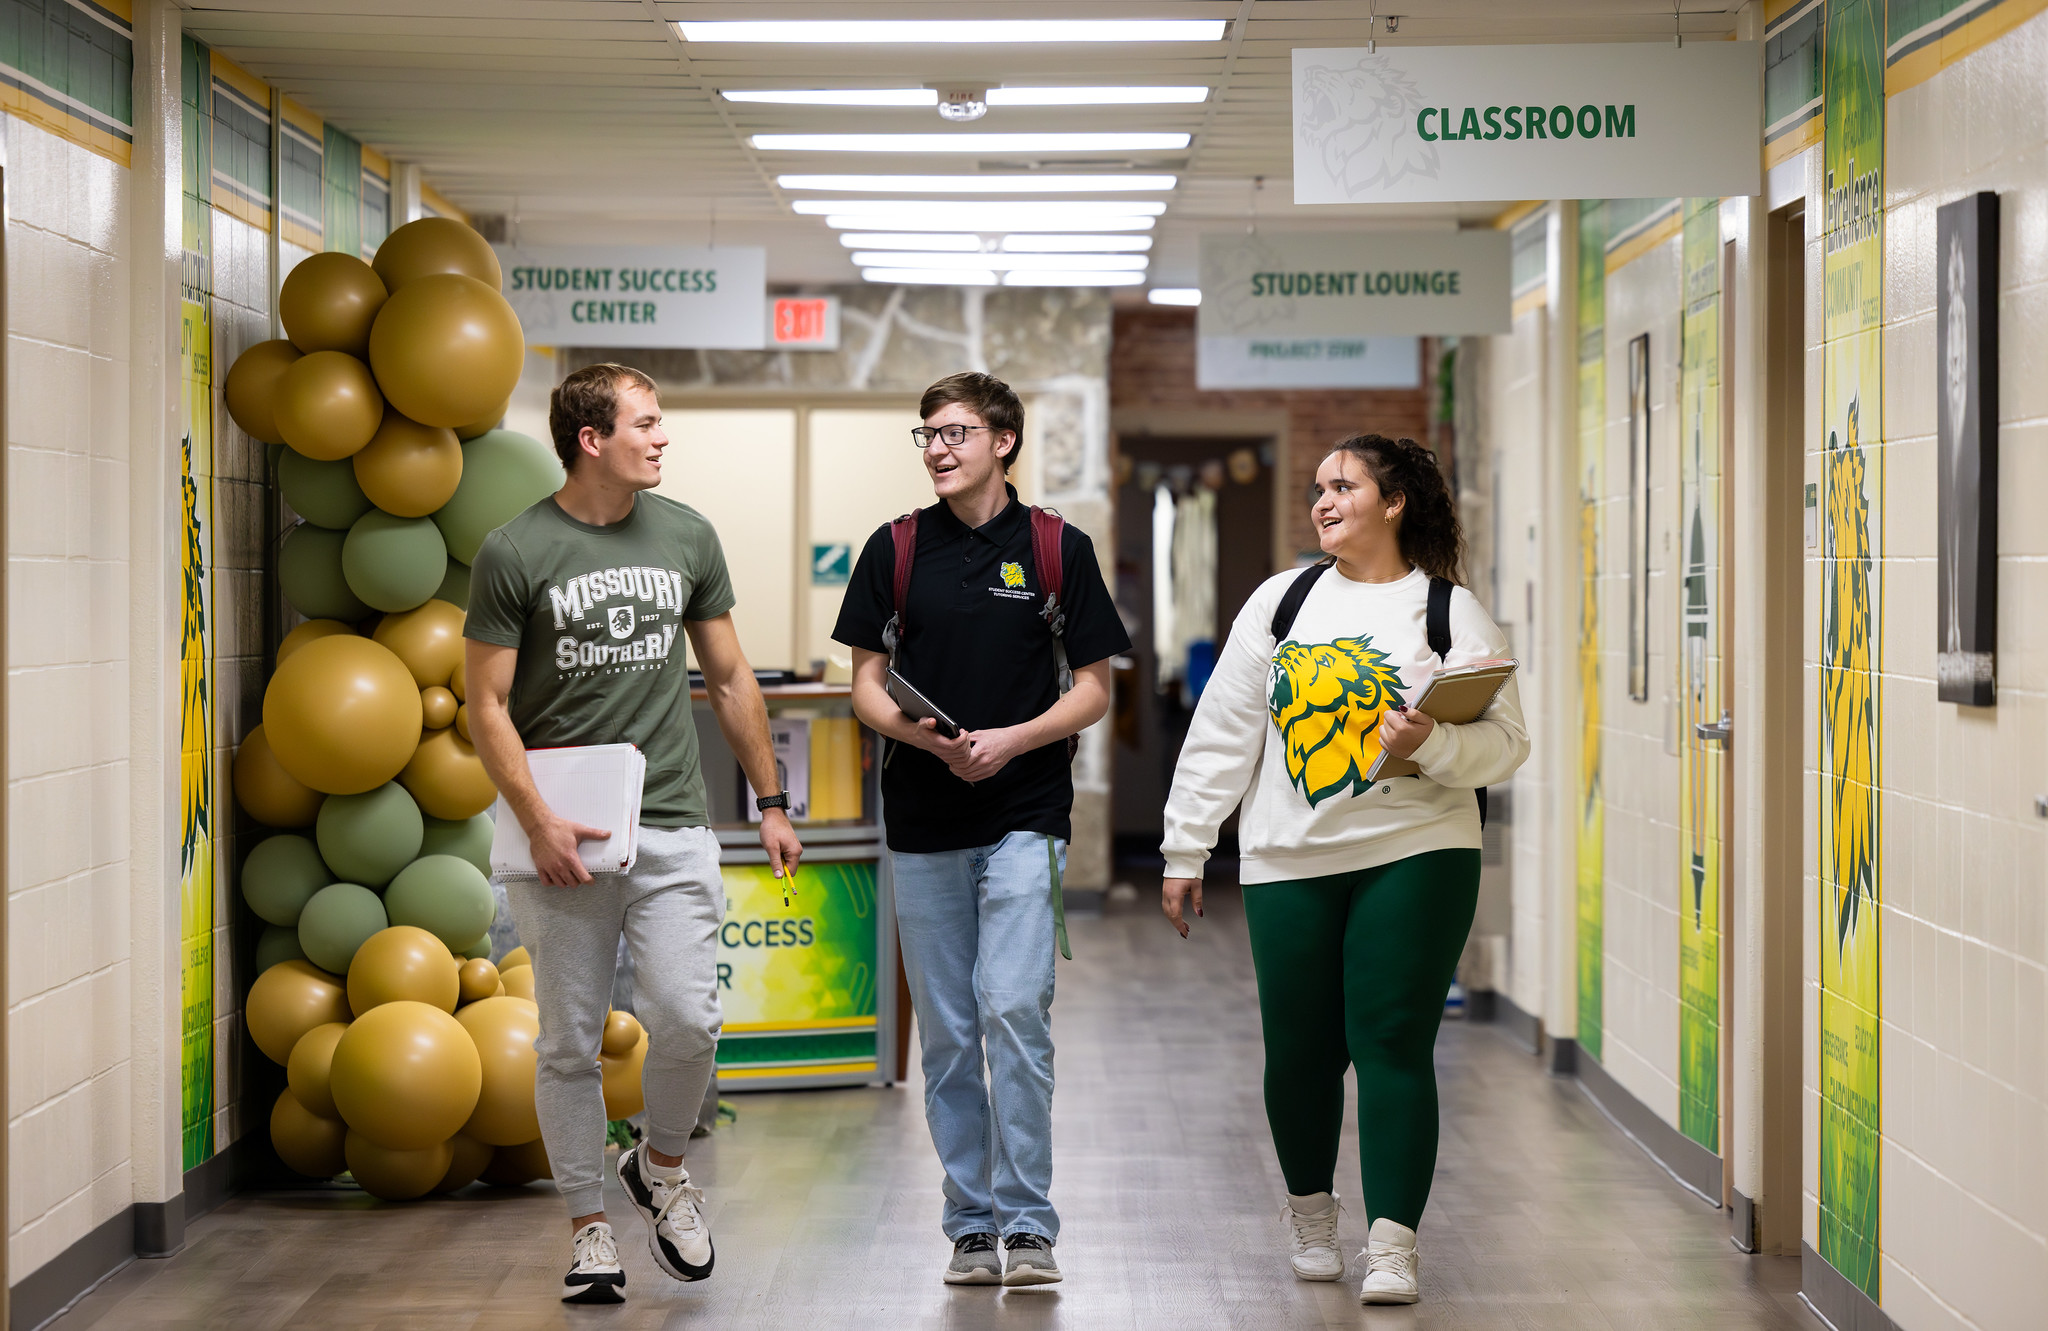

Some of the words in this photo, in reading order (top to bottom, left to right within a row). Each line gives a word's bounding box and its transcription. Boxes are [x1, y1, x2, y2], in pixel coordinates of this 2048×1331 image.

[1416, 104, 1636, 142] CLASSROOM
[1828, 158, 1879, 256] Excellence
[511, 266, 613, 292] STUDENT
[618, 268, 717, 293] SUCCESS
[1251, 271, 1358, 297] STUDENT
[1364, 270, 1461, 296] LOUNGE
[1827, 260, 1864, 319] COMMUNITY
[571, 300, 656, 324] CENTER
[774, 298, 827, 342] EXIT
[549, 566, 683, 631] MISSOURI
[586, 621, 604, 631] EST.
[640, 613, 660, 622] 1937
[555, 622, 679, 671] SOUTHERN
[558, 671, 595, 680] STATE
[716, 919, 814, 948] CCESS
[1829, 1076, 1876, 1150] EMPOWERMENT
